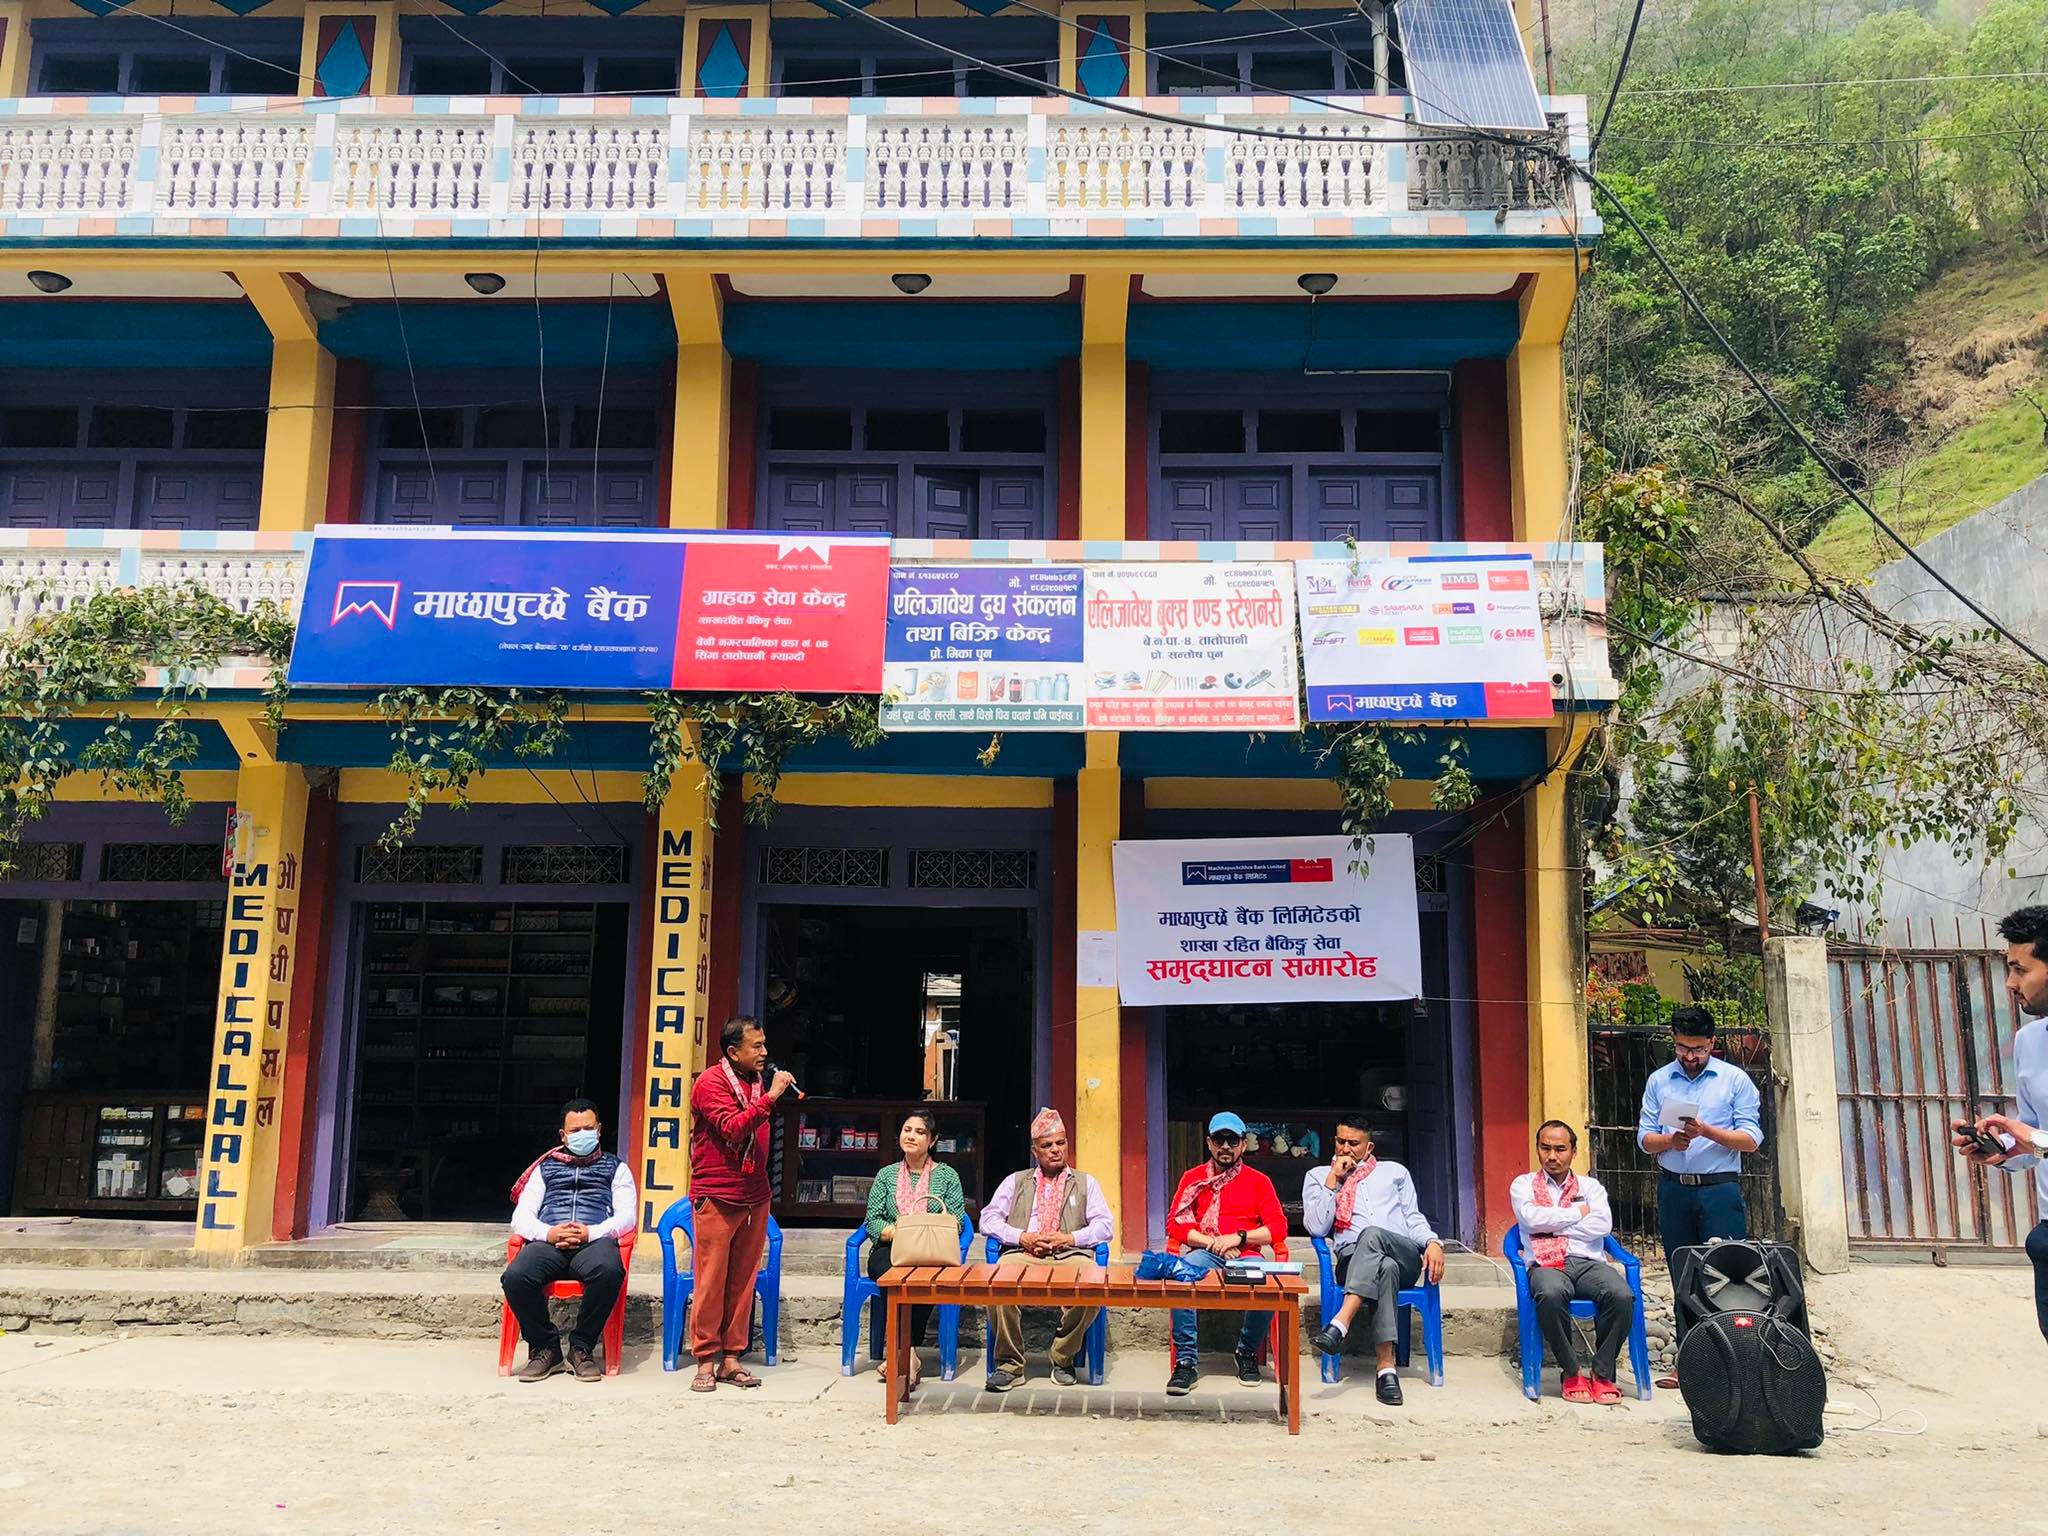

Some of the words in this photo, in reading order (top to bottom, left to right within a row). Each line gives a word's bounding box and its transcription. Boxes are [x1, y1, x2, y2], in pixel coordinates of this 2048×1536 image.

[413, 586, 570, 625] माछापुच्छ्रे
[584, 585, 651, 622] बैंक
[702, 590, 757, 606] ग्राहक
[762, 587, 798, 607] सेवा
[802, 587, 848, 608] केन्द्र
[1012, 591, 1077, 617] संकलन
[1157, 599, 1188, 636] बुक्स
[1192, 599, 1222, 628] एण्ड
[1226, 588, 1282, 629] स्टेशनरी
[718, 636, 778, 648] नगरपालिका
[906, 626, 944, 642] तथा
[1005, 622, 1052, 644] केन्द्र
[1199, 633, 1248, 646] तातोपानी
[1505, 628, 1536, 638] GME
[975, 649, 993, 661] पुन
[1168, 649, 1203, 659] सन्तोष
[1428, 691, 1457, 708] बैंक
[1235, 906, 1264, 926] बैंक
[1269, 904, 1362, 925] लिमिटेडको
[1179, 938, 1218, 953] शाखा
[1223, 935, 1259, 953] रहित
[1313, 933, 1341, 950] सेवा
[1281, 950, 1378, 978] समारोह
